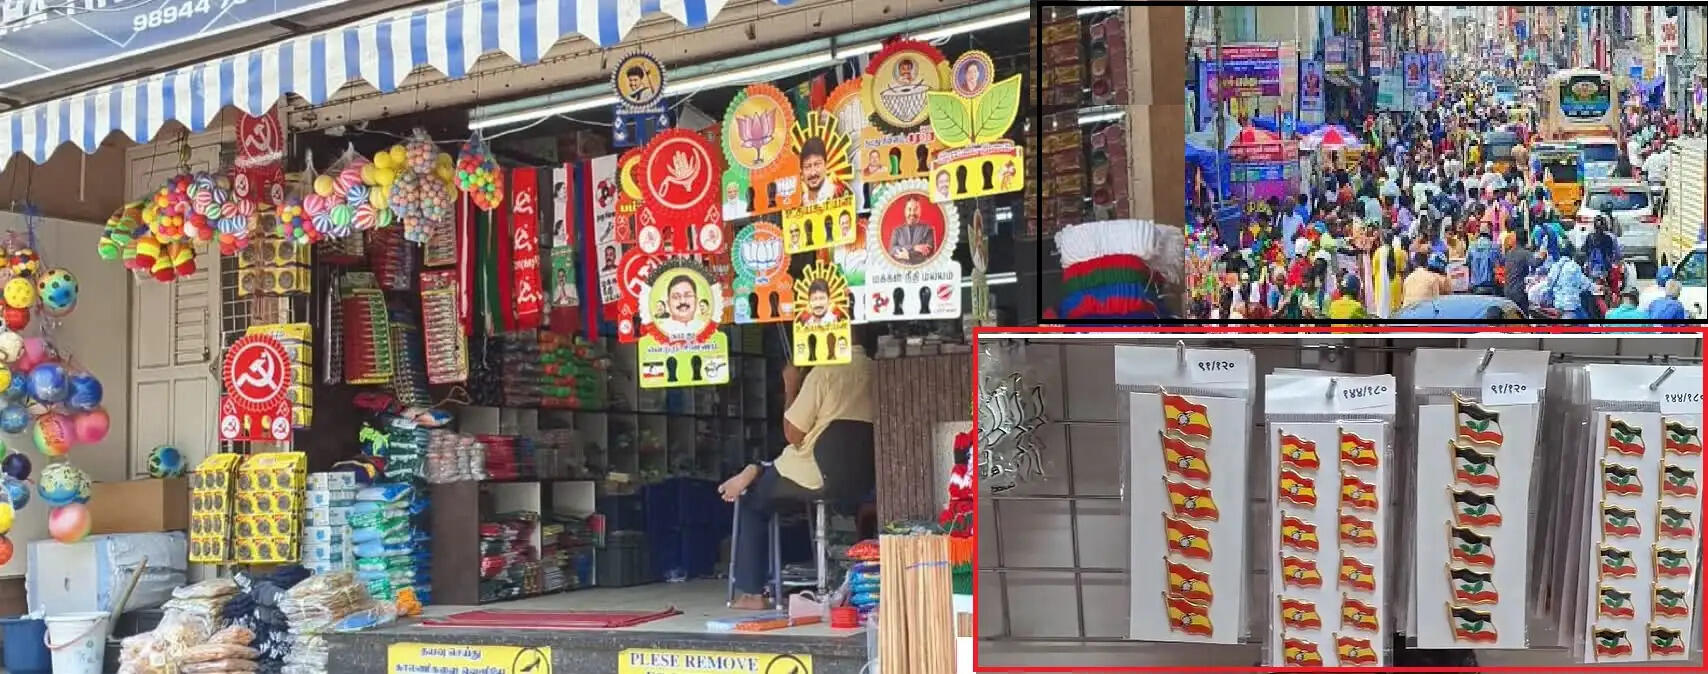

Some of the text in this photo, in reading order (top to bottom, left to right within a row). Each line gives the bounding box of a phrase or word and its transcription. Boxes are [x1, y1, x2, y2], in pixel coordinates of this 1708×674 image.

[132, 0, 211, 32] 98944
[630, 652, 759, 672] PLESE REMOVE
